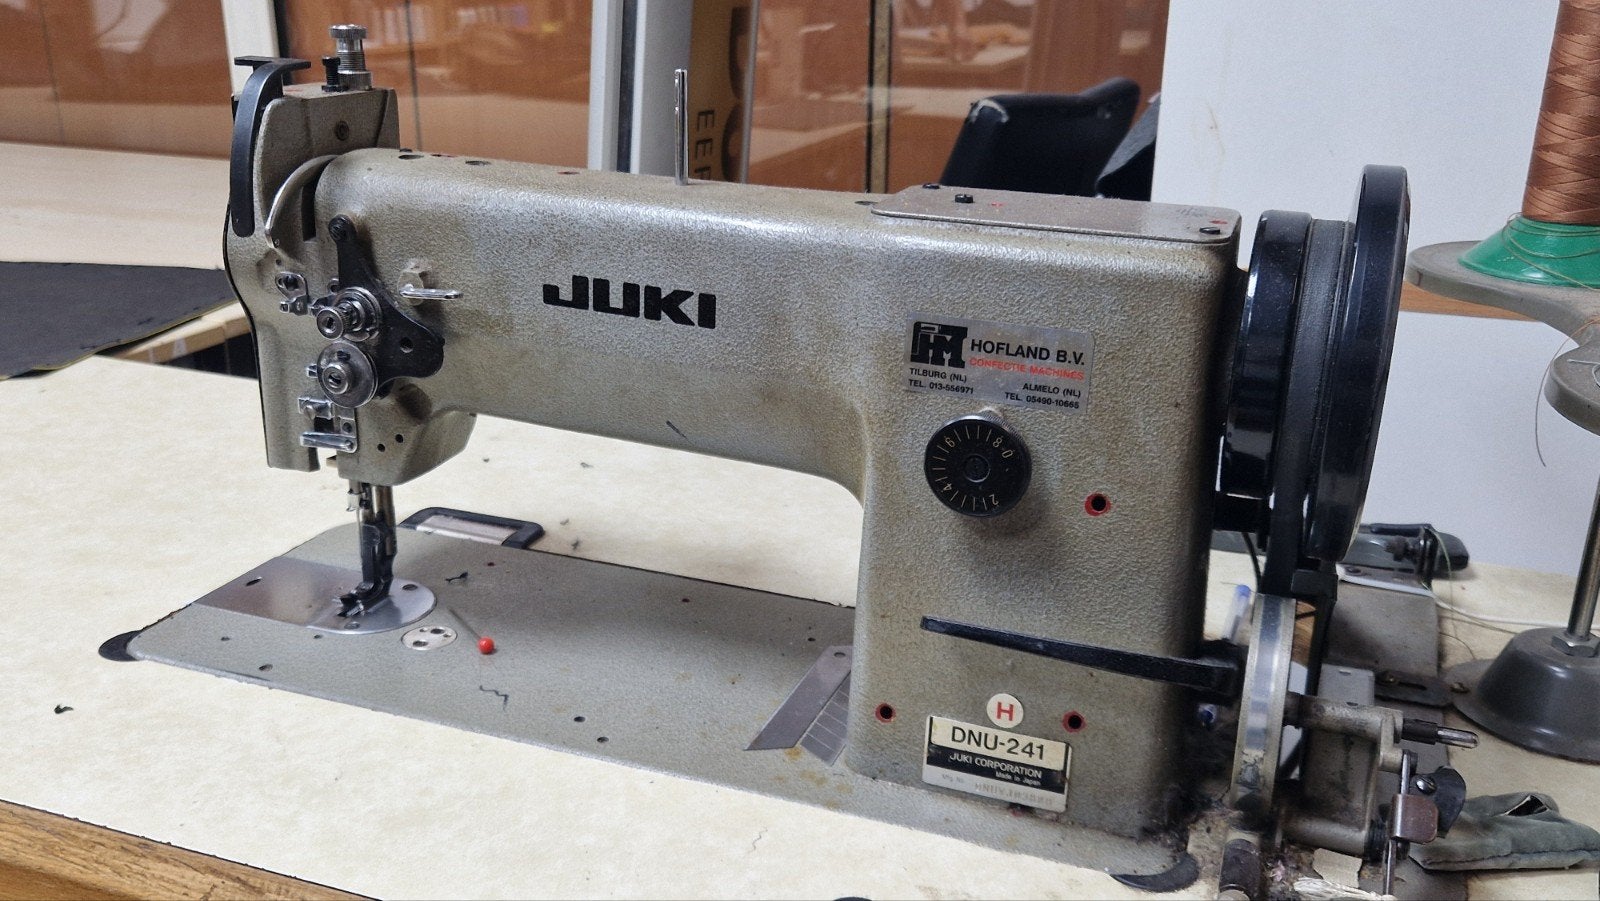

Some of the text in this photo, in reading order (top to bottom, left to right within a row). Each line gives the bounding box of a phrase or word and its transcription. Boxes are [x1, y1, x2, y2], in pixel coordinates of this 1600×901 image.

[543, 275, 717, 329] JUKI
[970, 338, 1085, 366] HOFLAND B.V.
[909, 368, 967, 383] TILBURG (NL)
[969, 357, 1085, 381] CONFECTIE MACHINES
[908, 379, 974, 395] TEL. 013-556971
[1022, 383, 1081, 399] ALMELO (NL)
[944, 437, 956, 448] 6
[992, 437, 1003, 448] 8
[1001, 449, 1014, 459] 0
[941, 483, 952, 493] 4
[988, 494, 999, 506] 2
[996, 701, 1015, 722] H
[951, 726, 1045, 761] DNU-241
[949, 752, 973, 764] JUKI
[974, 757, 1043, 779] CORPORATION
[995, 771, 1012, 780] Made
